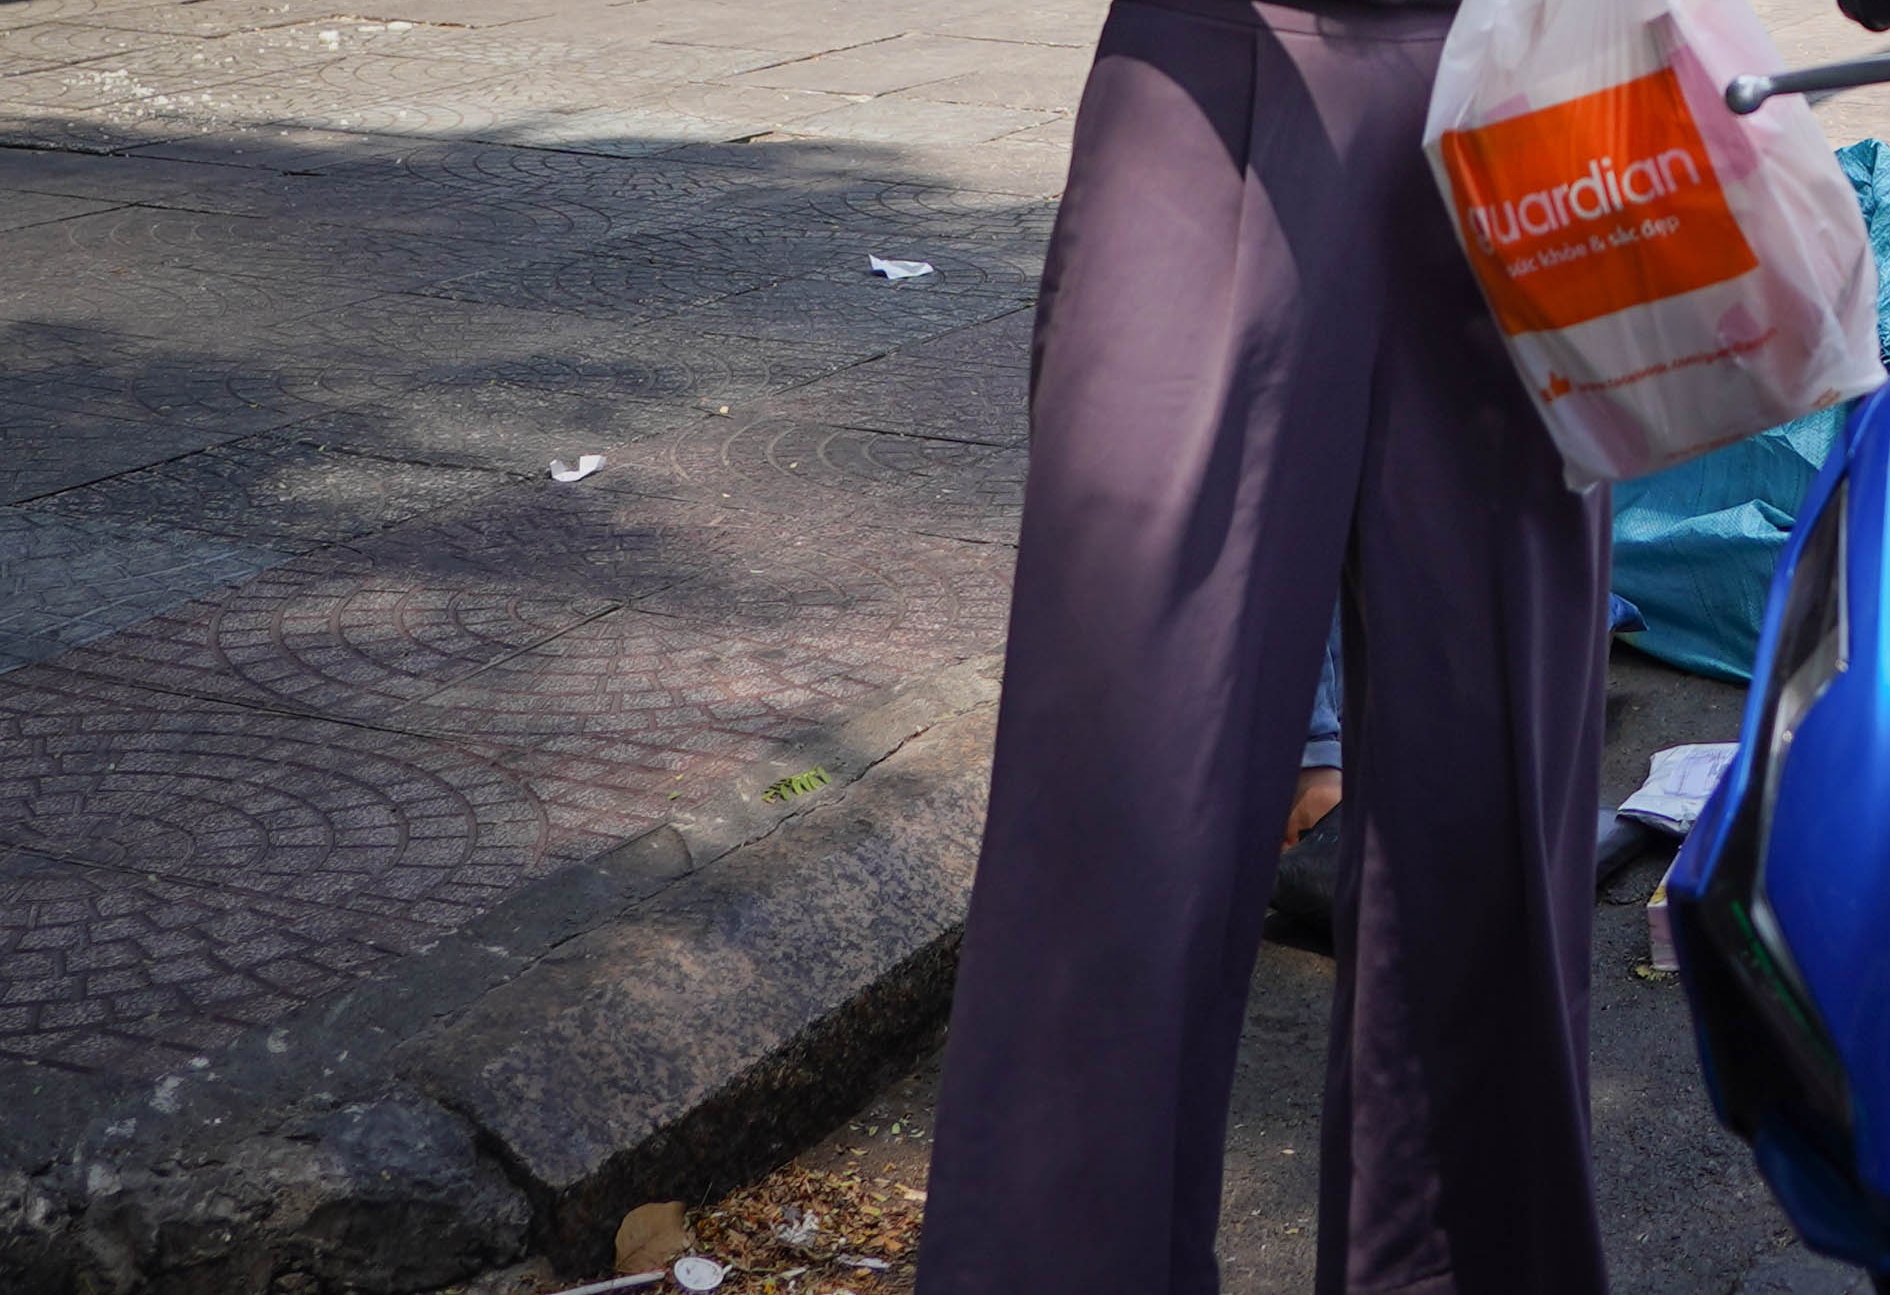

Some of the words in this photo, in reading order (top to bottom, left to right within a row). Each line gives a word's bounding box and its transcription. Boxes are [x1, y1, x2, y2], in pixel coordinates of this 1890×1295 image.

[1467, 147, 1702, 256] guardian
[1588, 235, 1606, 253] &
[1641, 214, 1680, 240] đẹp
